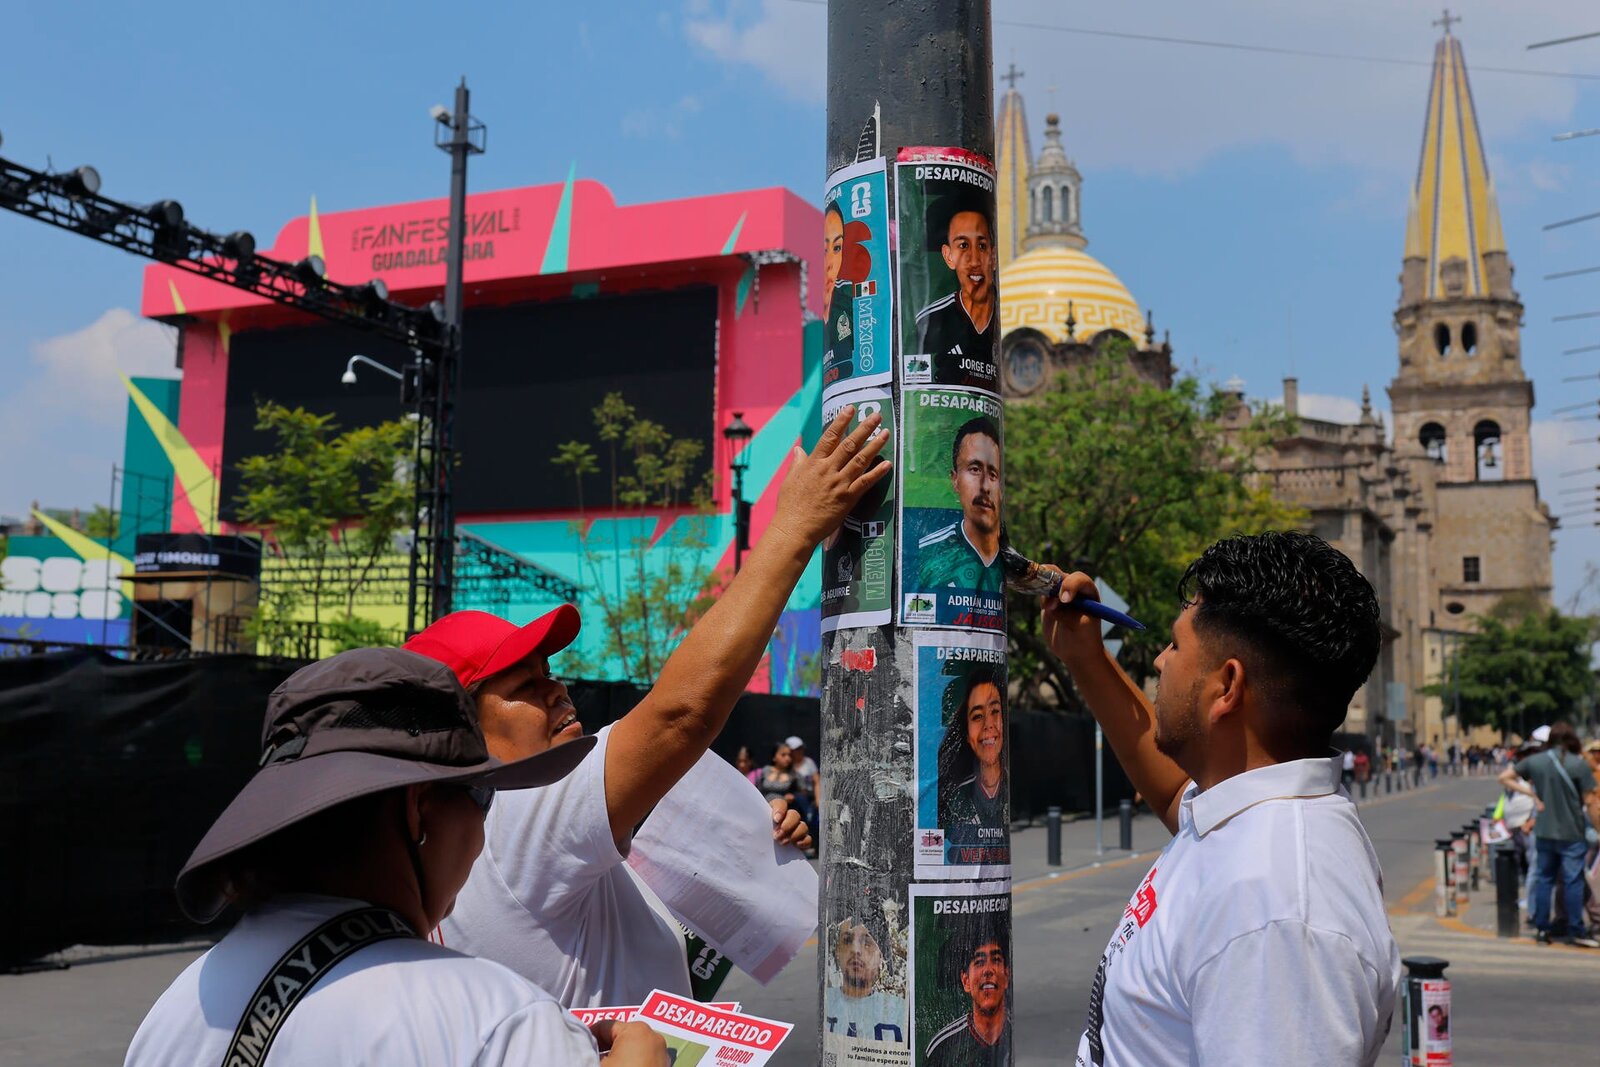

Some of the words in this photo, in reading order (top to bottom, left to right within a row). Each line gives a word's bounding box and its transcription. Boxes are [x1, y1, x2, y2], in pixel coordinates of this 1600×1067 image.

[915, 167, 994, 192] DESAPARECIDO
[371, 241, 495, 272] GUADALAARA
[858, 298, 877, 372] MÉXICO
[958, 358, 984, 373] JORGE
[953, 612, 1003, 628] JAISCO
[321, 911, 416, 955] LOLA
[653, 1001, 772, 1045] DESAPARECIDO
[715, 1045, 754, 1064] RICARDO
[854, 1054, 875, 1063] familia
